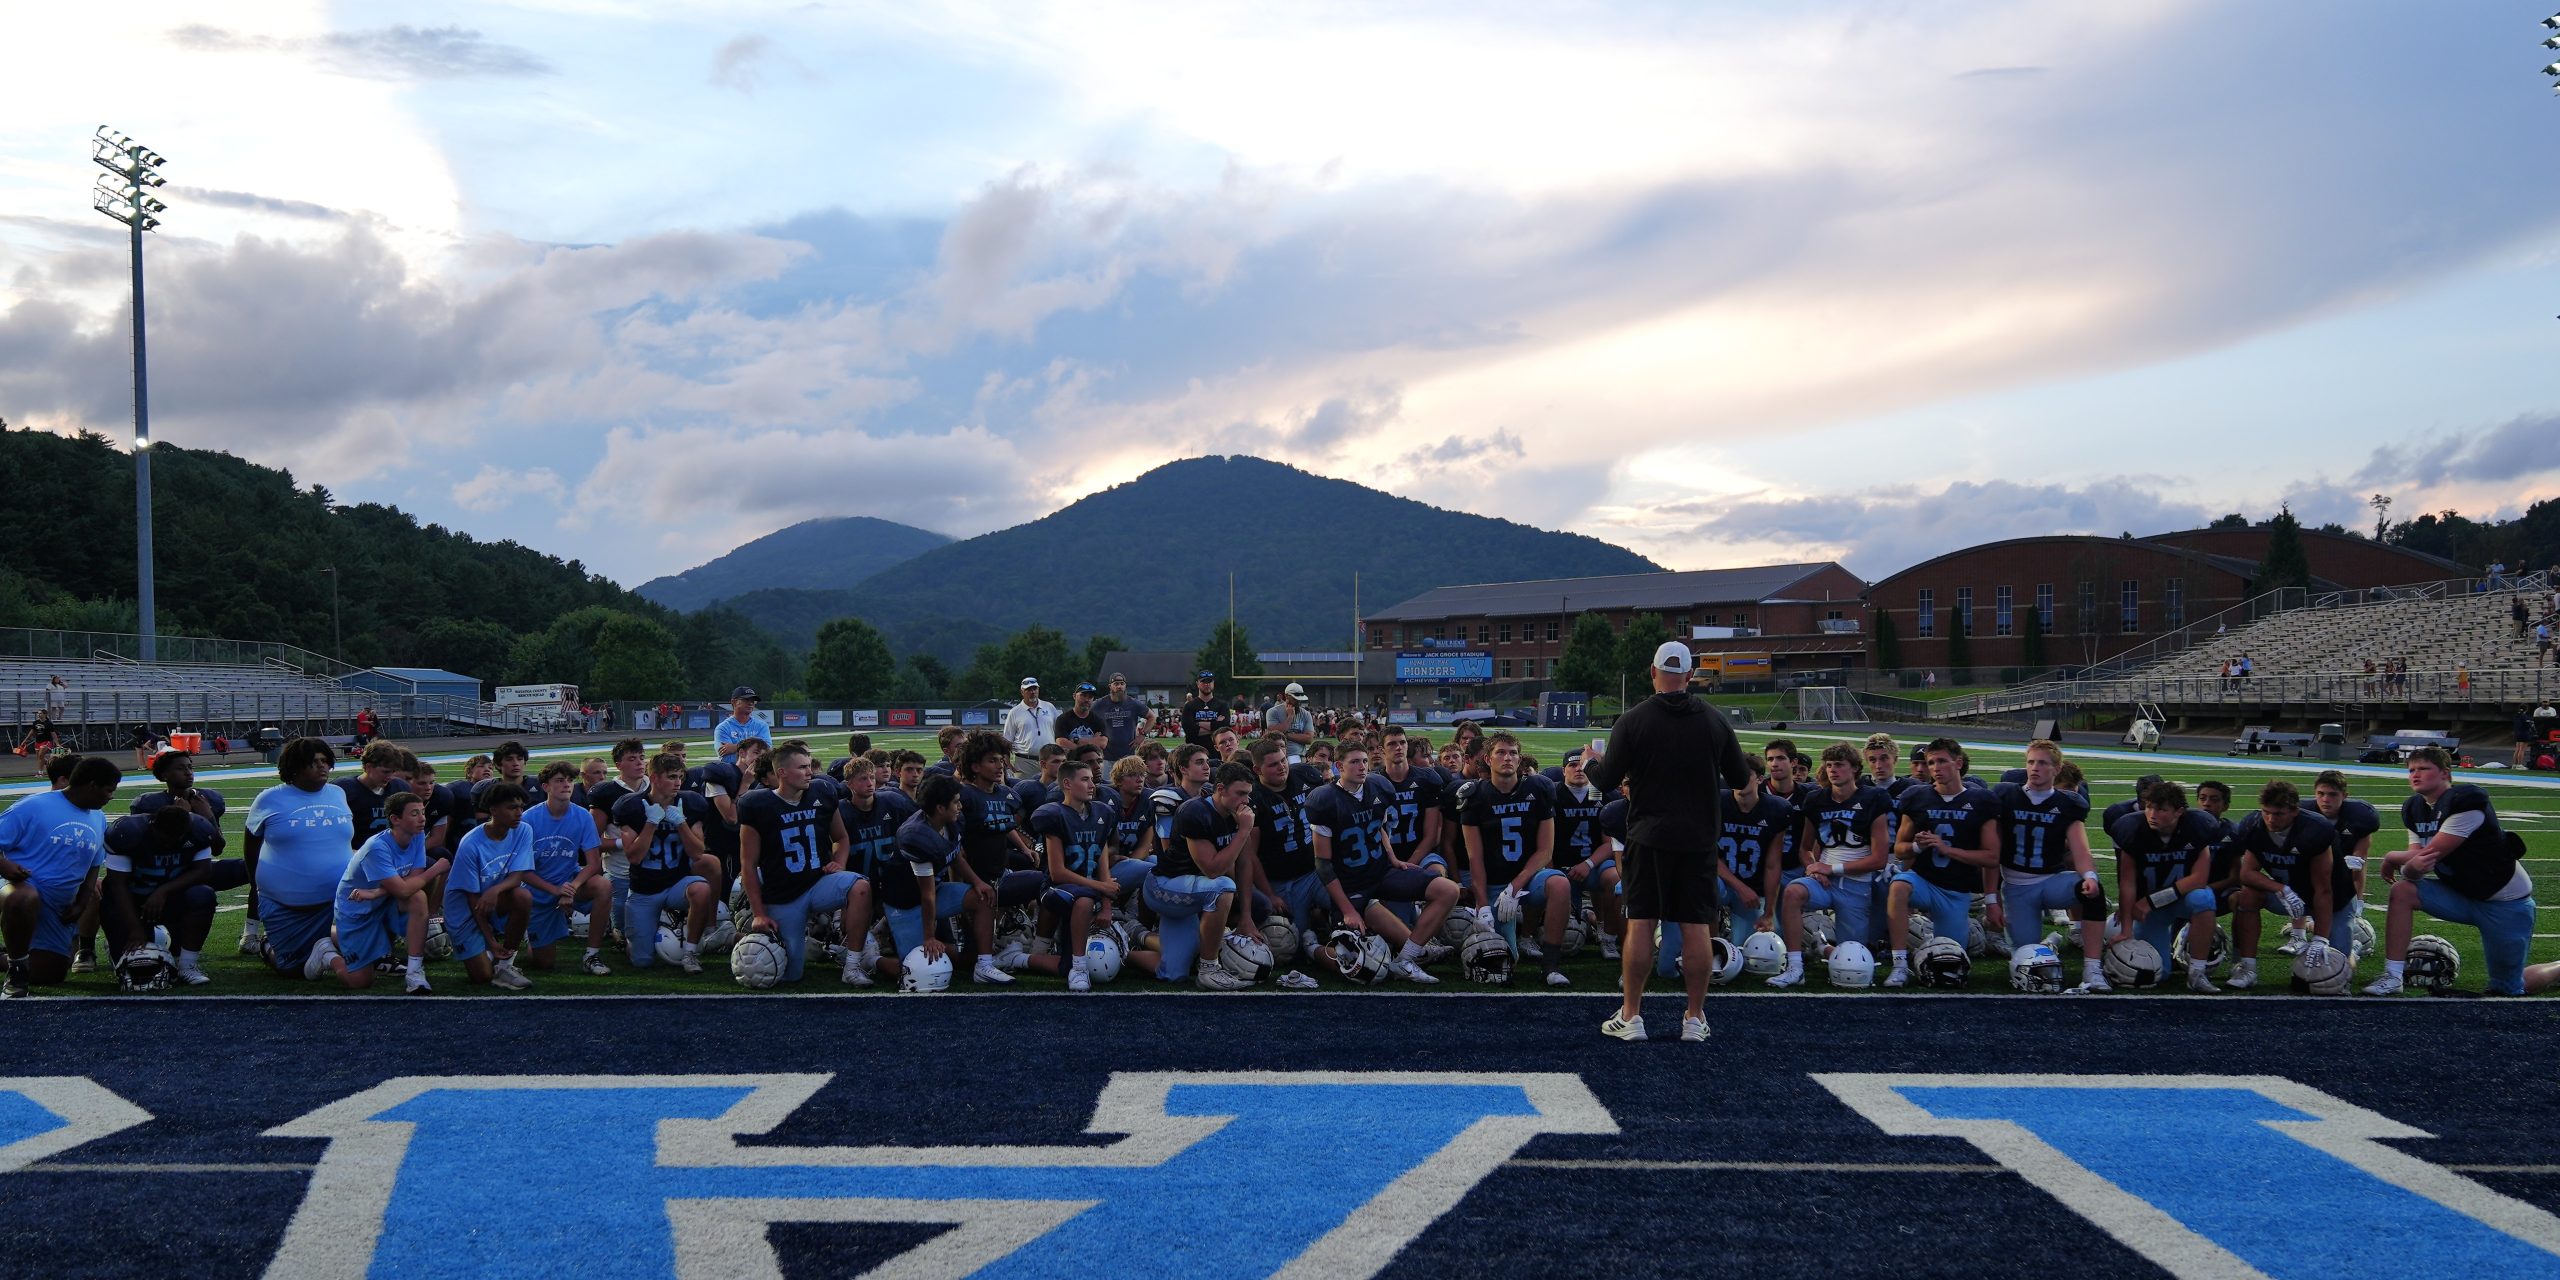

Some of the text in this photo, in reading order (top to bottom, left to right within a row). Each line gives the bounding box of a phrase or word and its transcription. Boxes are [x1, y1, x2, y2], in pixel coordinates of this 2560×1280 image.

[1404, 667, 1456, 676] PIONEERS
[1395, 791, 1415, 800] TW
[313, 810, 325, 818] W
[1492, 801, 1531, 814] WTW
[1563, 808, 1599, 816] WTW
[289, 816, 348, 827] TEAM
[780, 809, 816, 823] WTW
[1820, 810, 1857, 820] WTW
[1926, 809, 1969, 821] WTW
[2013, 810, 2057, 824] WTW
[1382, 803, 1418, 844] 27
[1723, 822, 1762, 836] WTW
[74, 828, 84, 837] W
[1500, 816, 1523, 861] 5
[1570, 820, 1592, 857] 4
[50, 835, 97, 851] TEAM
[780, 824, 821, 873] 51
[1931, 823, 1955, 869] 6
[2012, 824, 2046, 868] 11
[640, 832, 684, 870] 20
[1717, 836, 1761, 879] 33
[2144, 851, 2189, 863] WTW
[2263, 851, 2296, 865] WTW
[2144, 864, 2185, 890] 14
